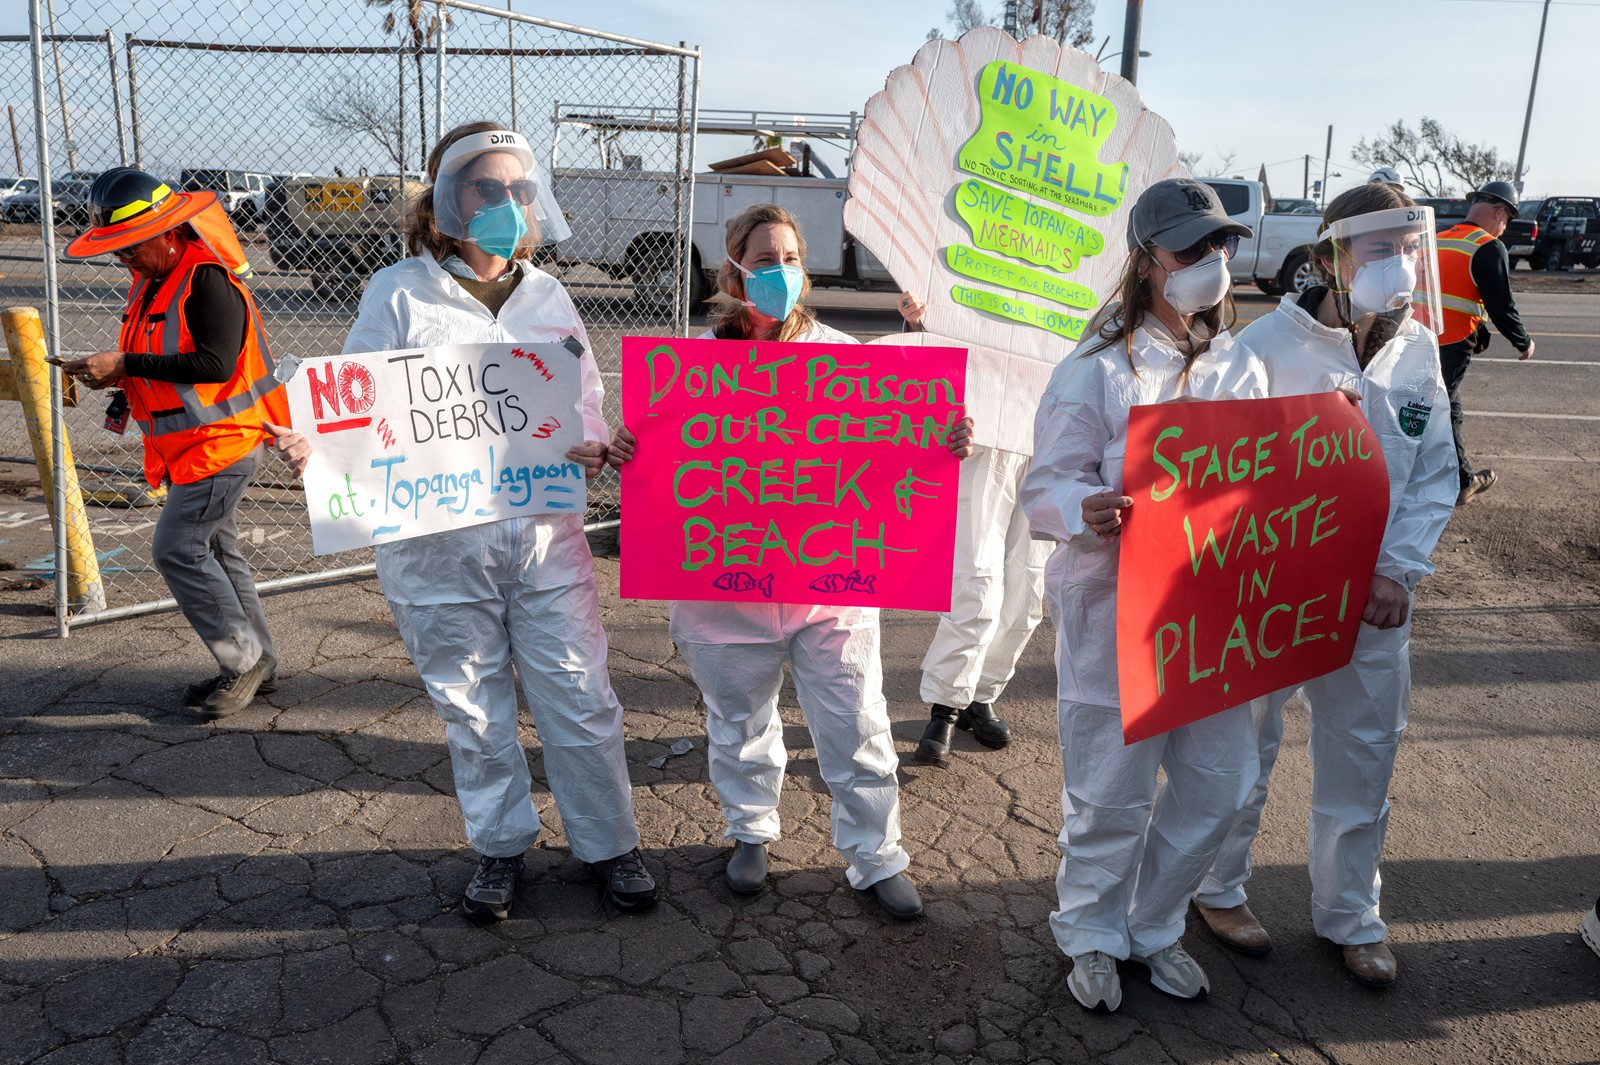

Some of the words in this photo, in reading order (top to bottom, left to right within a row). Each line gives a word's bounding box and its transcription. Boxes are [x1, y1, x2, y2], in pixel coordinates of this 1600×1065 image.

[992, 63, 1034, 110] NO
[1049, 89, 1107, 137] WAY
[1026, 123, 1066, 150] in
[964, 159, 977, 170] NO
[980, 162, 1006, 182] TOXIC
[1009, 174, 1039, 192] SORTING
[1039, 185, 1049, 195] AT
[1050, 189, 1062, 200] THE
[1064, 194, 1098, 212] SEASHORE
[989, 131, 1129, 206] SHELL!
[962, 180, 1014, 221] SAVE
[1022, 201, 1099, 251] TOPANGA'S
[979, 219, 1073, 269] MERMAIDS
[954, 245, 1015, 281] PROTECT
[1019, 276, 1040, 289] OUR
[1043, 281, 1093, 307] BEACHES!
[957, 285, 985, 306] THIS
[989, 295, 999, 308] IS
[1002, 302, 1027, 320] OUR
[1036, 308, 1083, 337] HOME
[306, 361, 376, 419] NO
[388, 354, 508, 405] TOXIC
[410, 395, 528, 443] DEBRIS
[680, 406, 800, 449] OUR
[806, 410, 957, 449] CLEAN
[328, 473, 364, 521] at
[371, 455, 483, 520] Topanga
[489, 445, 582, 507] Lagoon
[673, 456, 871, 511] CREEK
[1150, 426, 1278, 502] STAGE
[1289, 415, 1373, 480] TOXIC
[681, 516, 890, 571] BEACH
[1183, 494, 1340, 577] WASTE
[1237, 560, 1276, 608] IN
[1155, 580, 1350, 697] PLACE!
